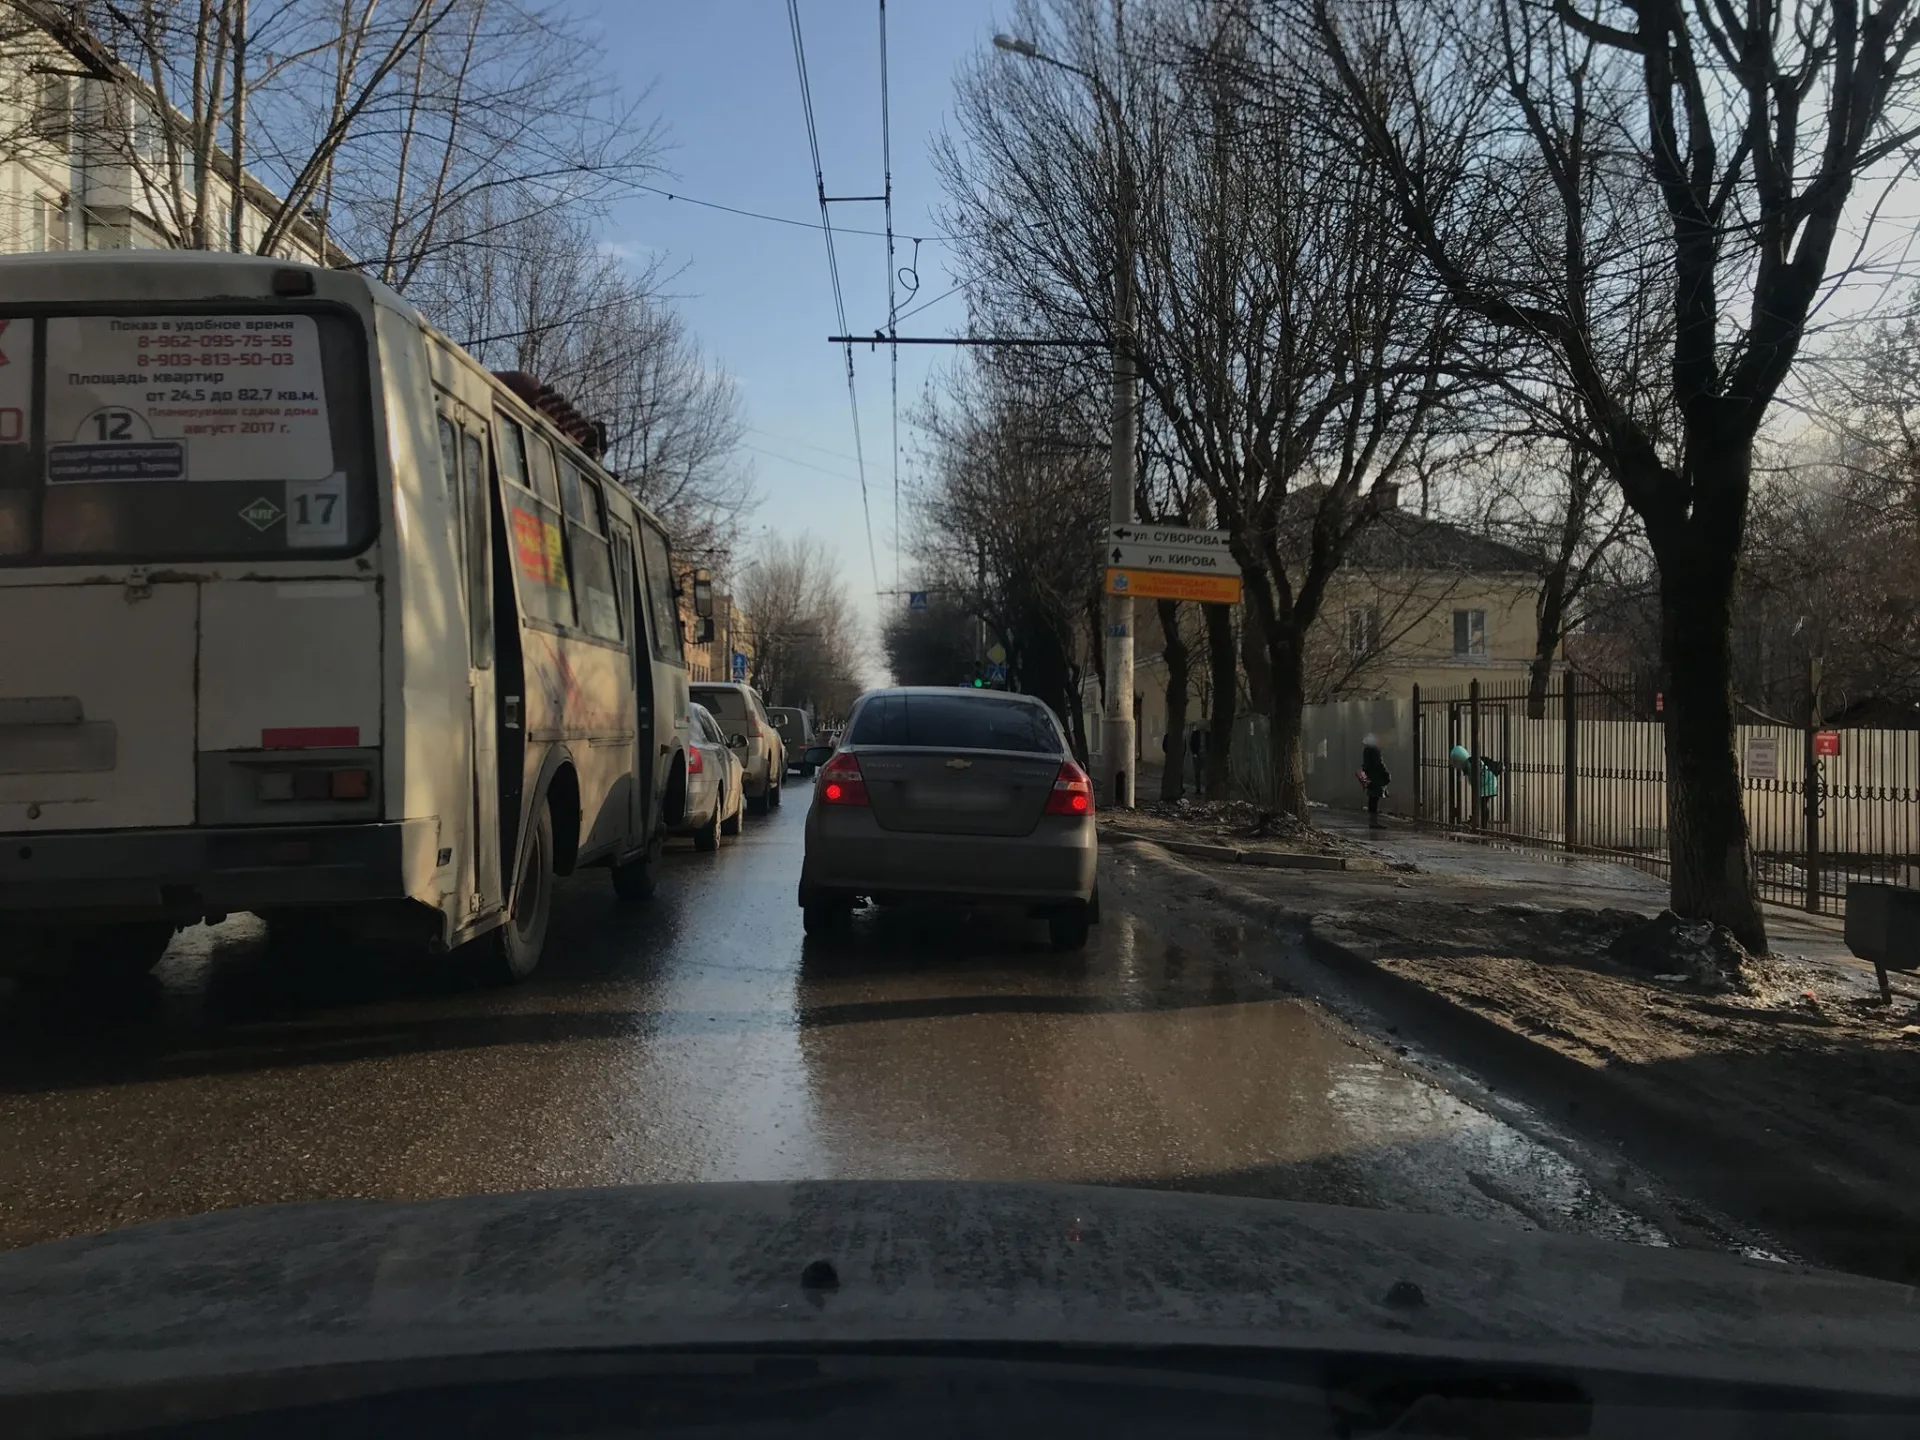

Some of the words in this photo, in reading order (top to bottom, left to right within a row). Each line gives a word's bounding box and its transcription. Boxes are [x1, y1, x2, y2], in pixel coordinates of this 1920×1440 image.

[110, 320, 158, 331] Показ
[162, 322, 171, 330] в
[176, 320, 241, 331] удобное
[246, 321, 294, 331] время
[138, 335, 293, 348] 8-962-095-75-55
[137, 352, 294, 367] 8-903-813-50-03
[68, 372, 148, 386] Площадь
[152, 371, 224, 385] квартир
[146, 392, 165, 402] от
[170, 389, 205, 402] 24,5
[210, 390, 232, 403] до
[237, 388, 272, 402] 82,7
[277, 389, 319, 402] кв.м.
[147, 406, 238, 418] Планируемая
[241, 407, 280, 417] сдача
[284, 407, 319, 418] дома
[93, 412, 133, 441] 12
[184, 422, 236, 436] август
[240, 421, 276, 434] 2017
[279, 423, 291, 434] г.
[293, 493, 339, 525] 17
[1133, 531, 1151, 542] ул.
[1154, 531, 1219, 546] СУВОРОВА
[1148, 554, 1165, 565] ул.
[1168, 553, 1217, 567] КИРОВА
